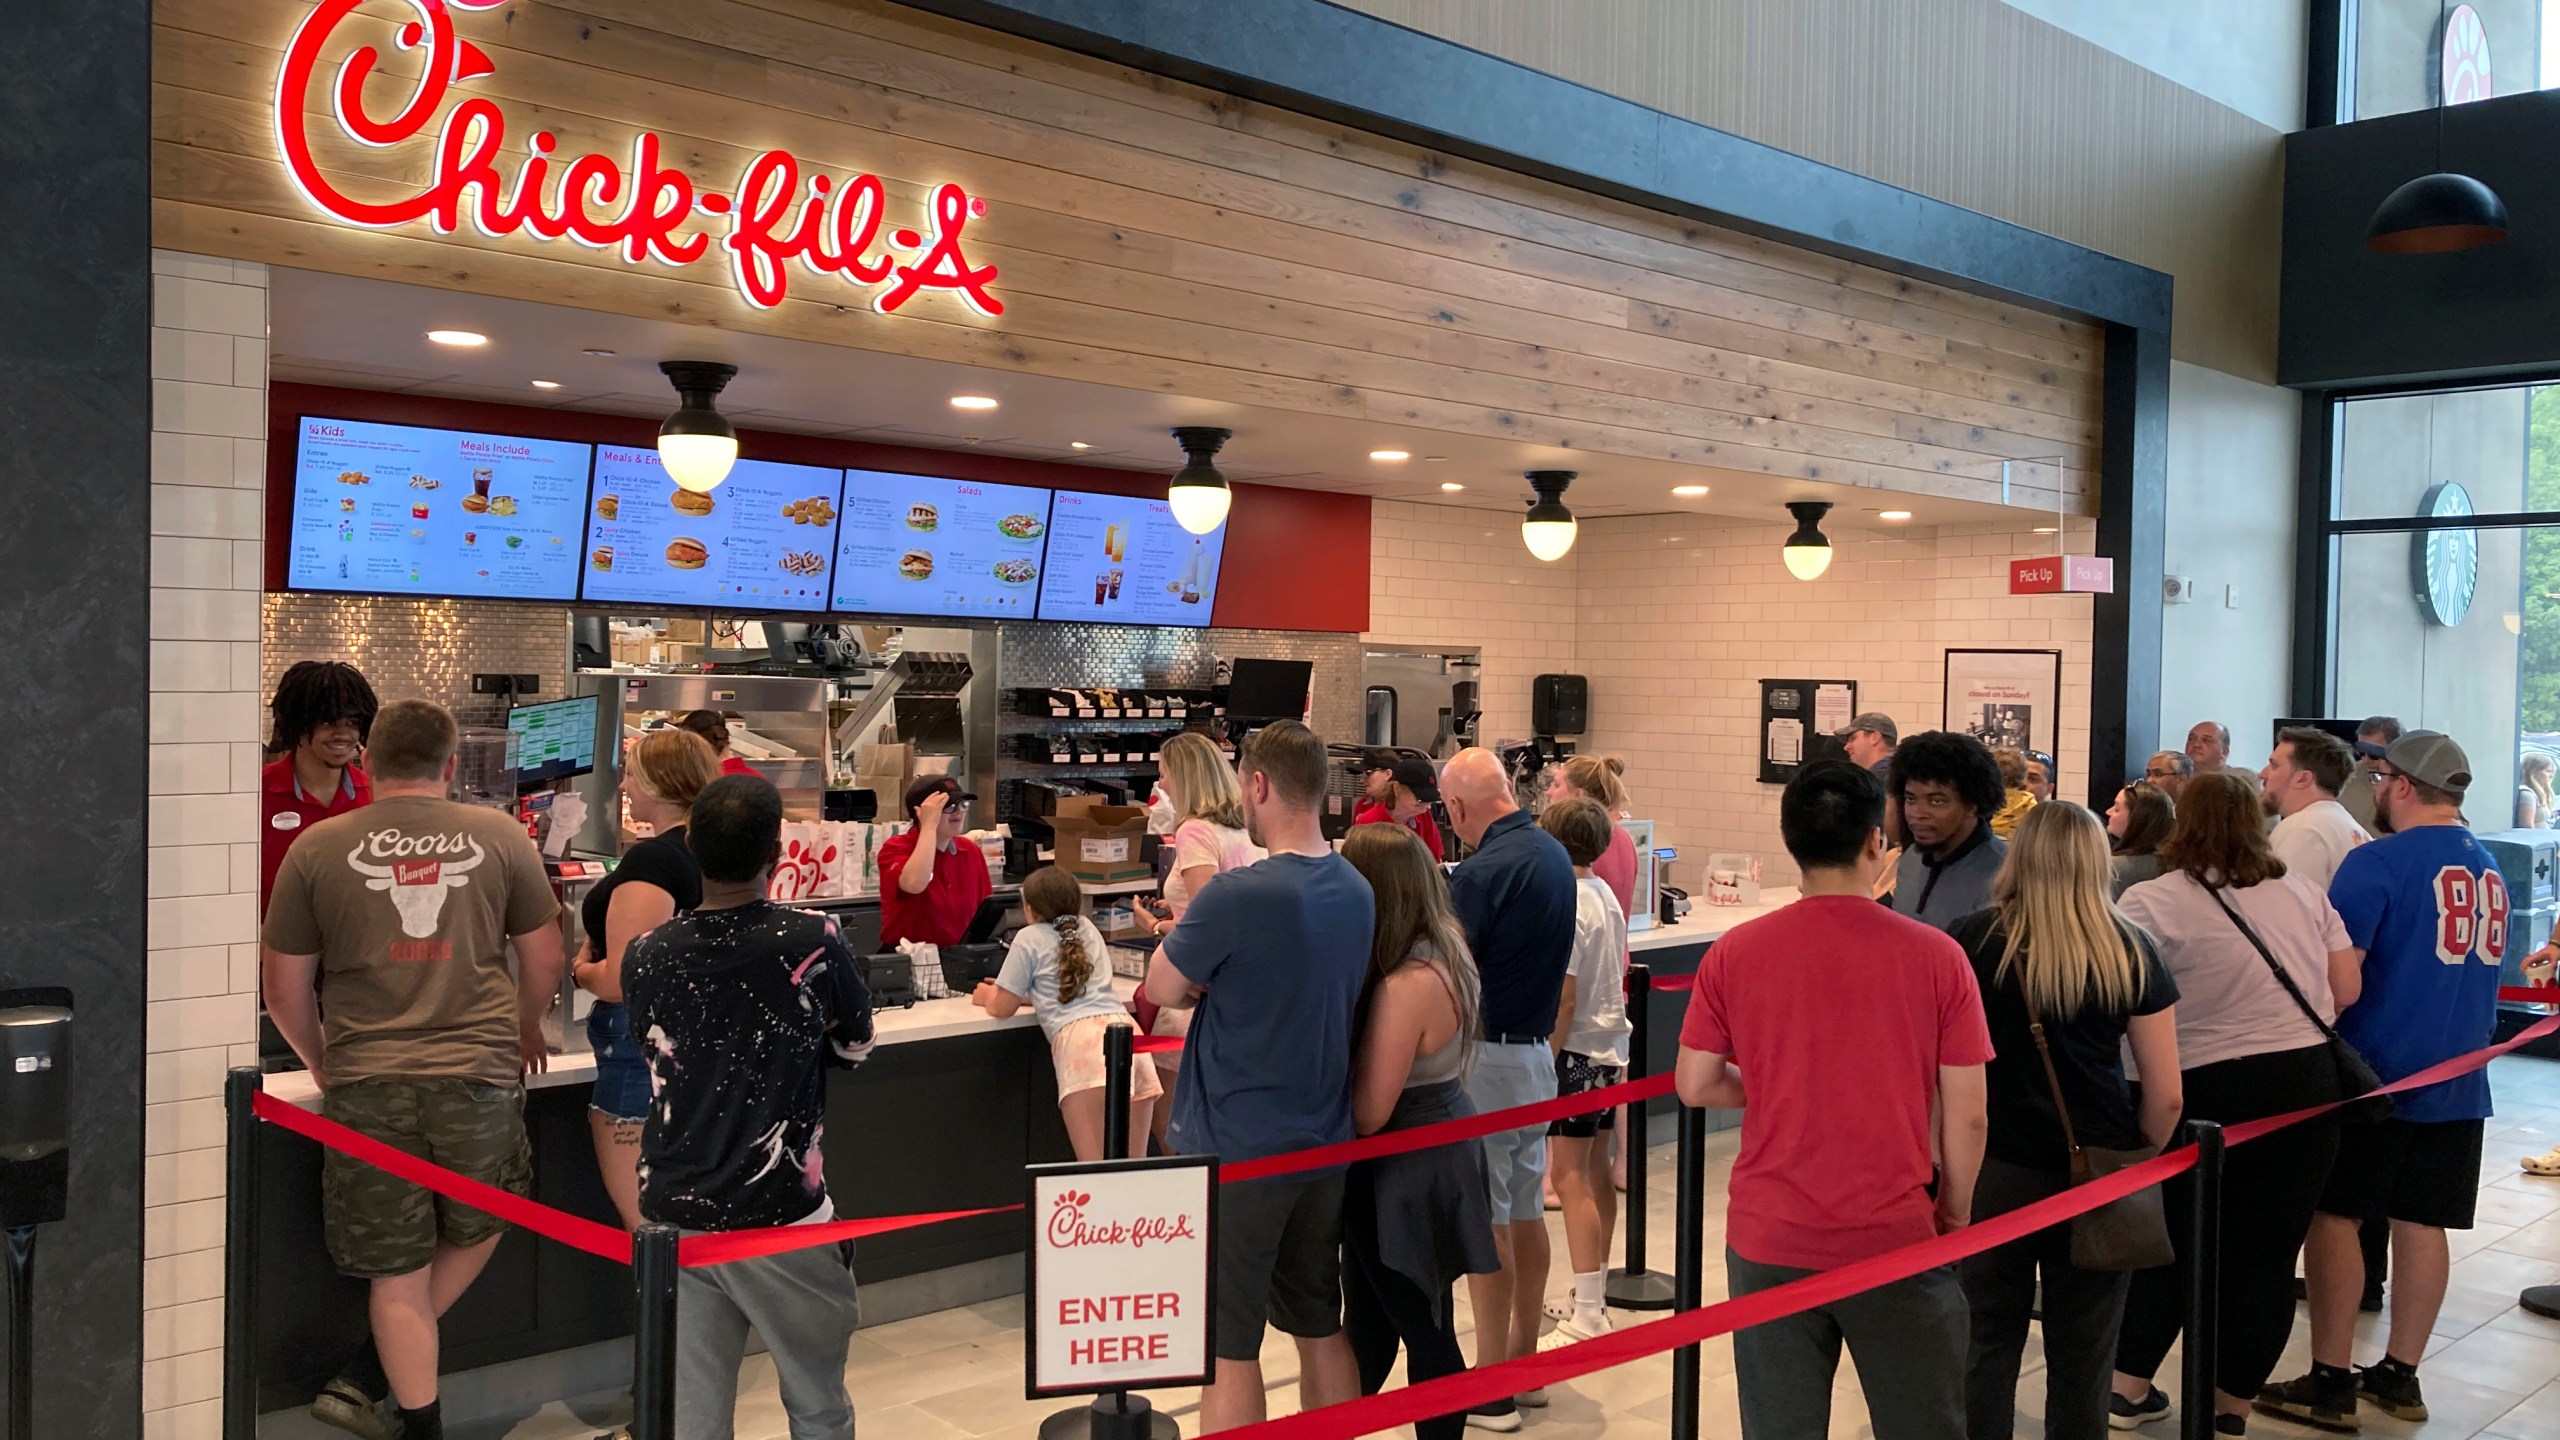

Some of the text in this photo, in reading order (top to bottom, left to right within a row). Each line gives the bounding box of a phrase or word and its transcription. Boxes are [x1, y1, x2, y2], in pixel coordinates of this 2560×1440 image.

[276, 0, 1003, 315] Chick-fil-A
[321, 425, 345, 437] Kids
[461, 440, 530, 455] Meals Include
[604, 451, 632, 462] Meals
[635, 454, 641, 463] &
[603, 475, 609, 486] 1
[727, 486, 734, 498] 3
[957, 485, 982, 495] Salads
[848, 496, 855, 507] 5
[1059, 495, 1082, 505] Drinks
[1149, 504, 1169, 513] Treats
[595, 526, 603, 538] 2
[721, 536, 729, 547] 4
[843, 544, 850, 555] 6
[2020, 568, 2053, 584] Pick Up
[2076, 567, 2091, 580] Pick
[2002, 691, 2030, 700] Sunday?
[368, 828, 468, 858] Coors
[399, 862, 438, 884] Banquet
[2432, 865, 2510, 966] 88
[1047, 1204, 1196, 1249] Chick-fil-A
[1059, 1292, 1180, 1325] ENTER
[1070, 1334, 1169, 1365] HERE
